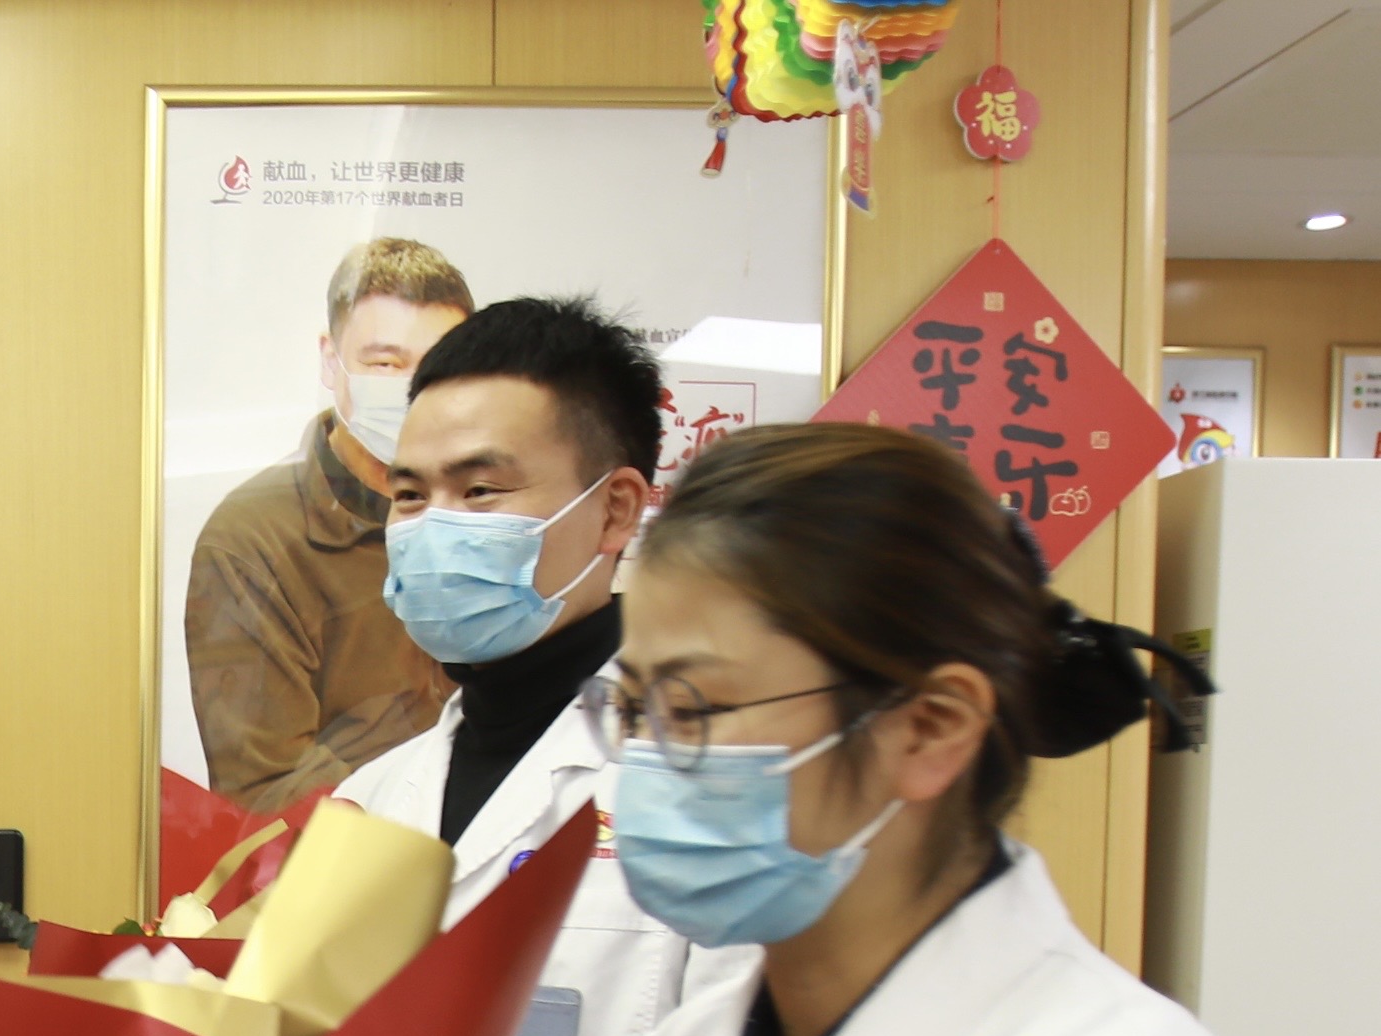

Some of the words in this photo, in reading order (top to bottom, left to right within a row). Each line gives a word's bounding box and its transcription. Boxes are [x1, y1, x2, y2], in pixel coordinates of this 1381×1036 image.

[975, 91, 1021, 141] 福
[263, 161, 465, 183] 献血，让世界更健康
[262, 190, 464, 207] 2020年第17个世界献血者日
[912, 320, 1068, 415] 平安
